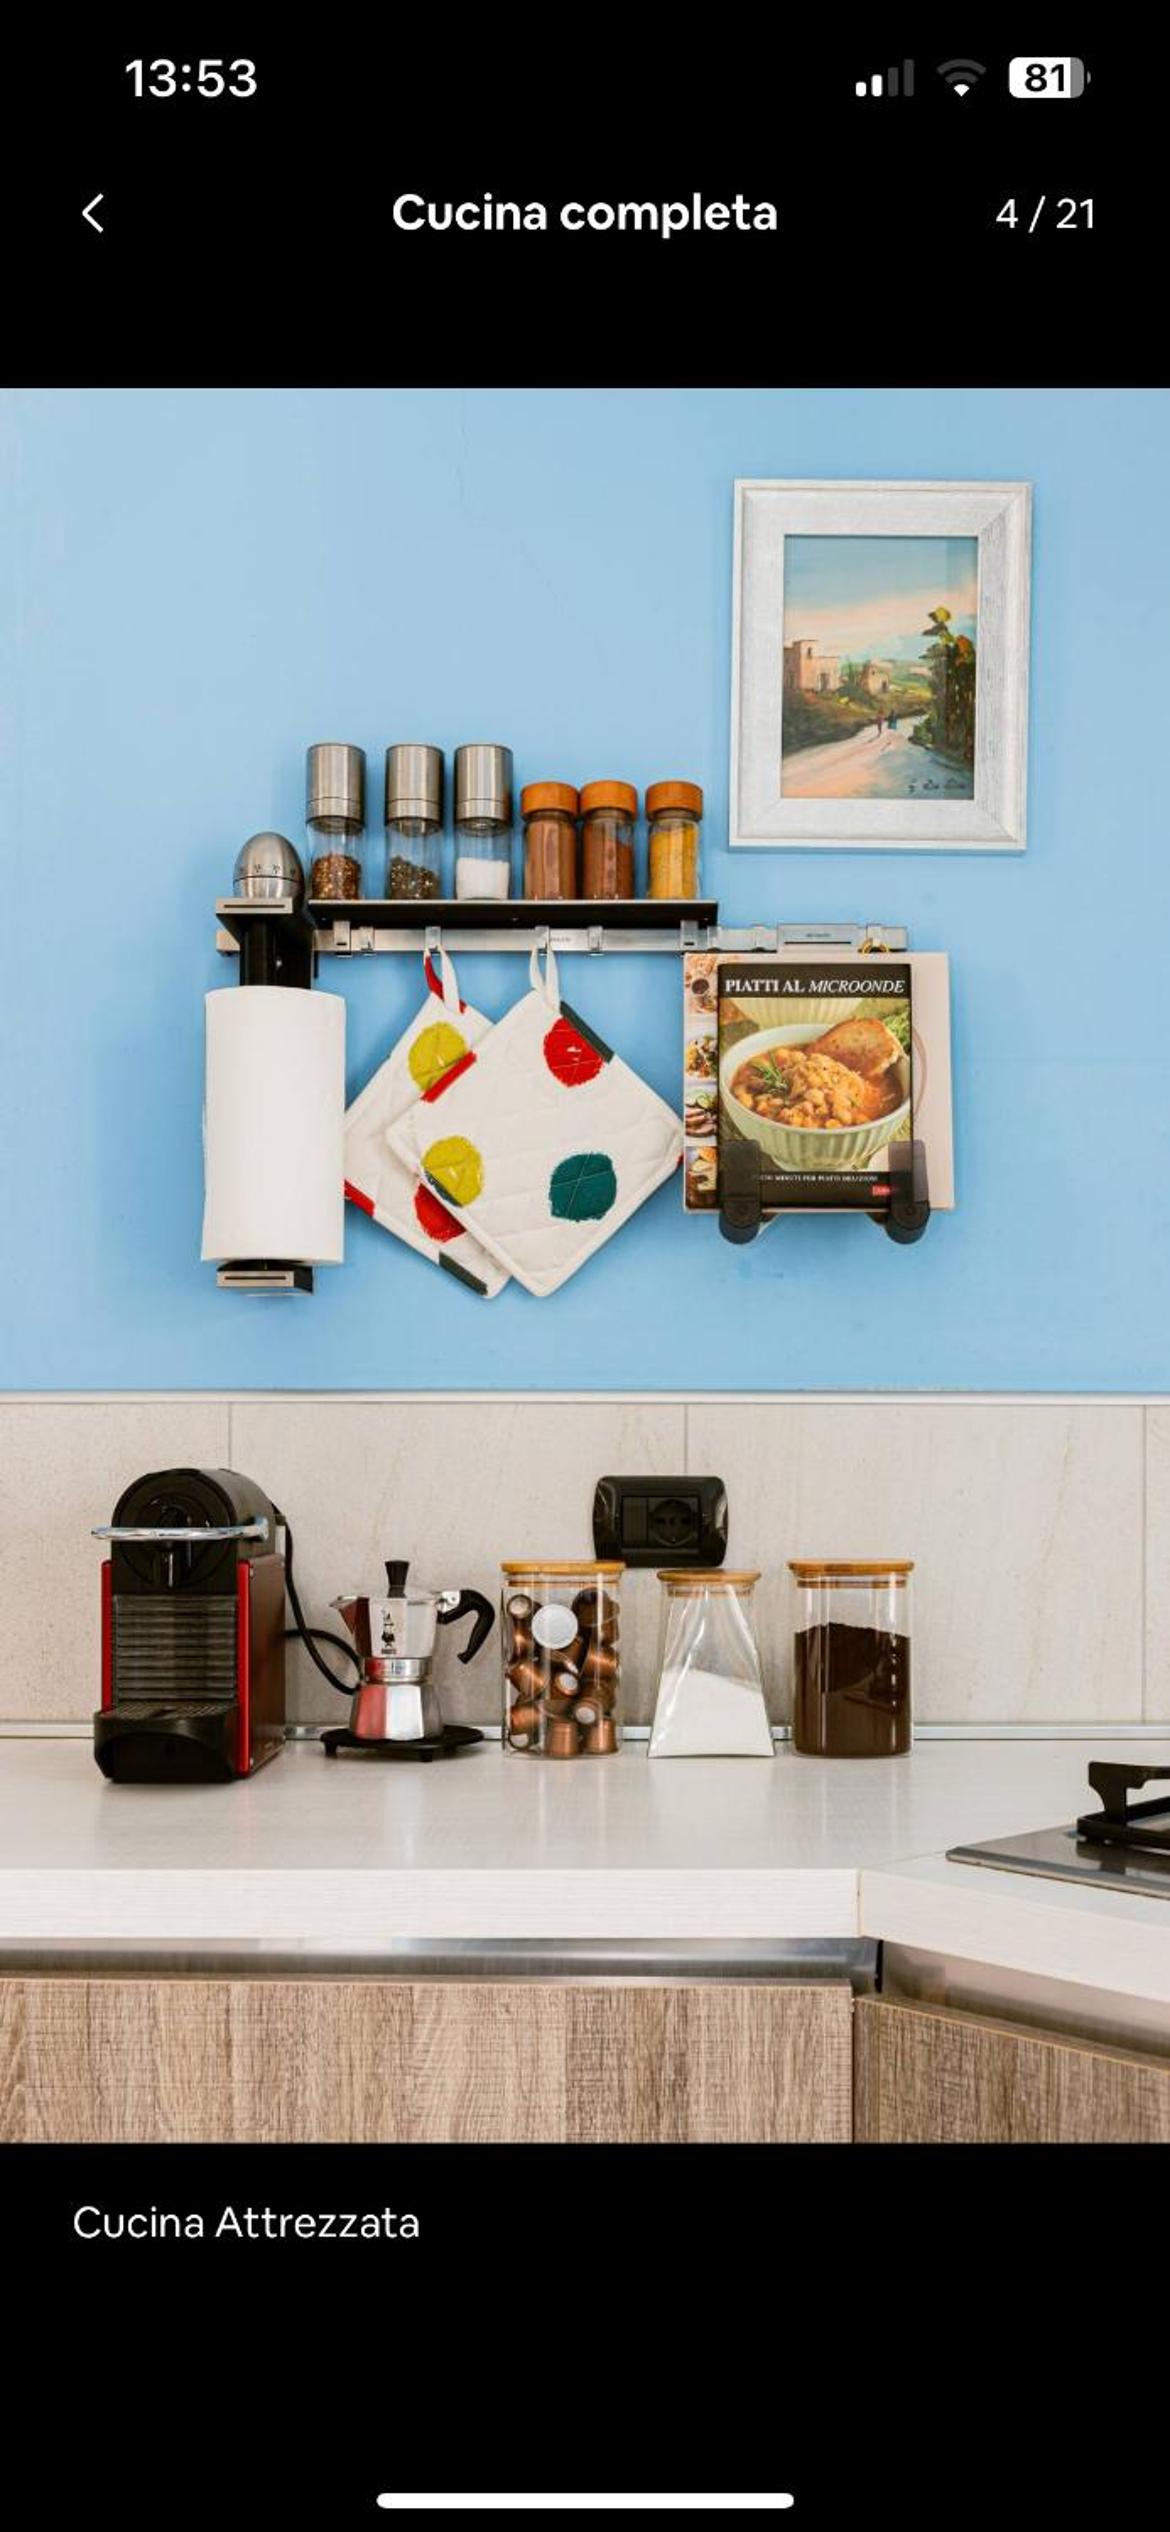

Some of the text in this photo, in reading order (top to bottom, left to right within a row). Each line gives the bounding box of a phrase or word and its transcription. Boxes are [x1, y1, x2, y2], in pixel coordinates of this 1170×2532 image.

[725, 979, 905, 993] PIATTI AL MICROONDE
